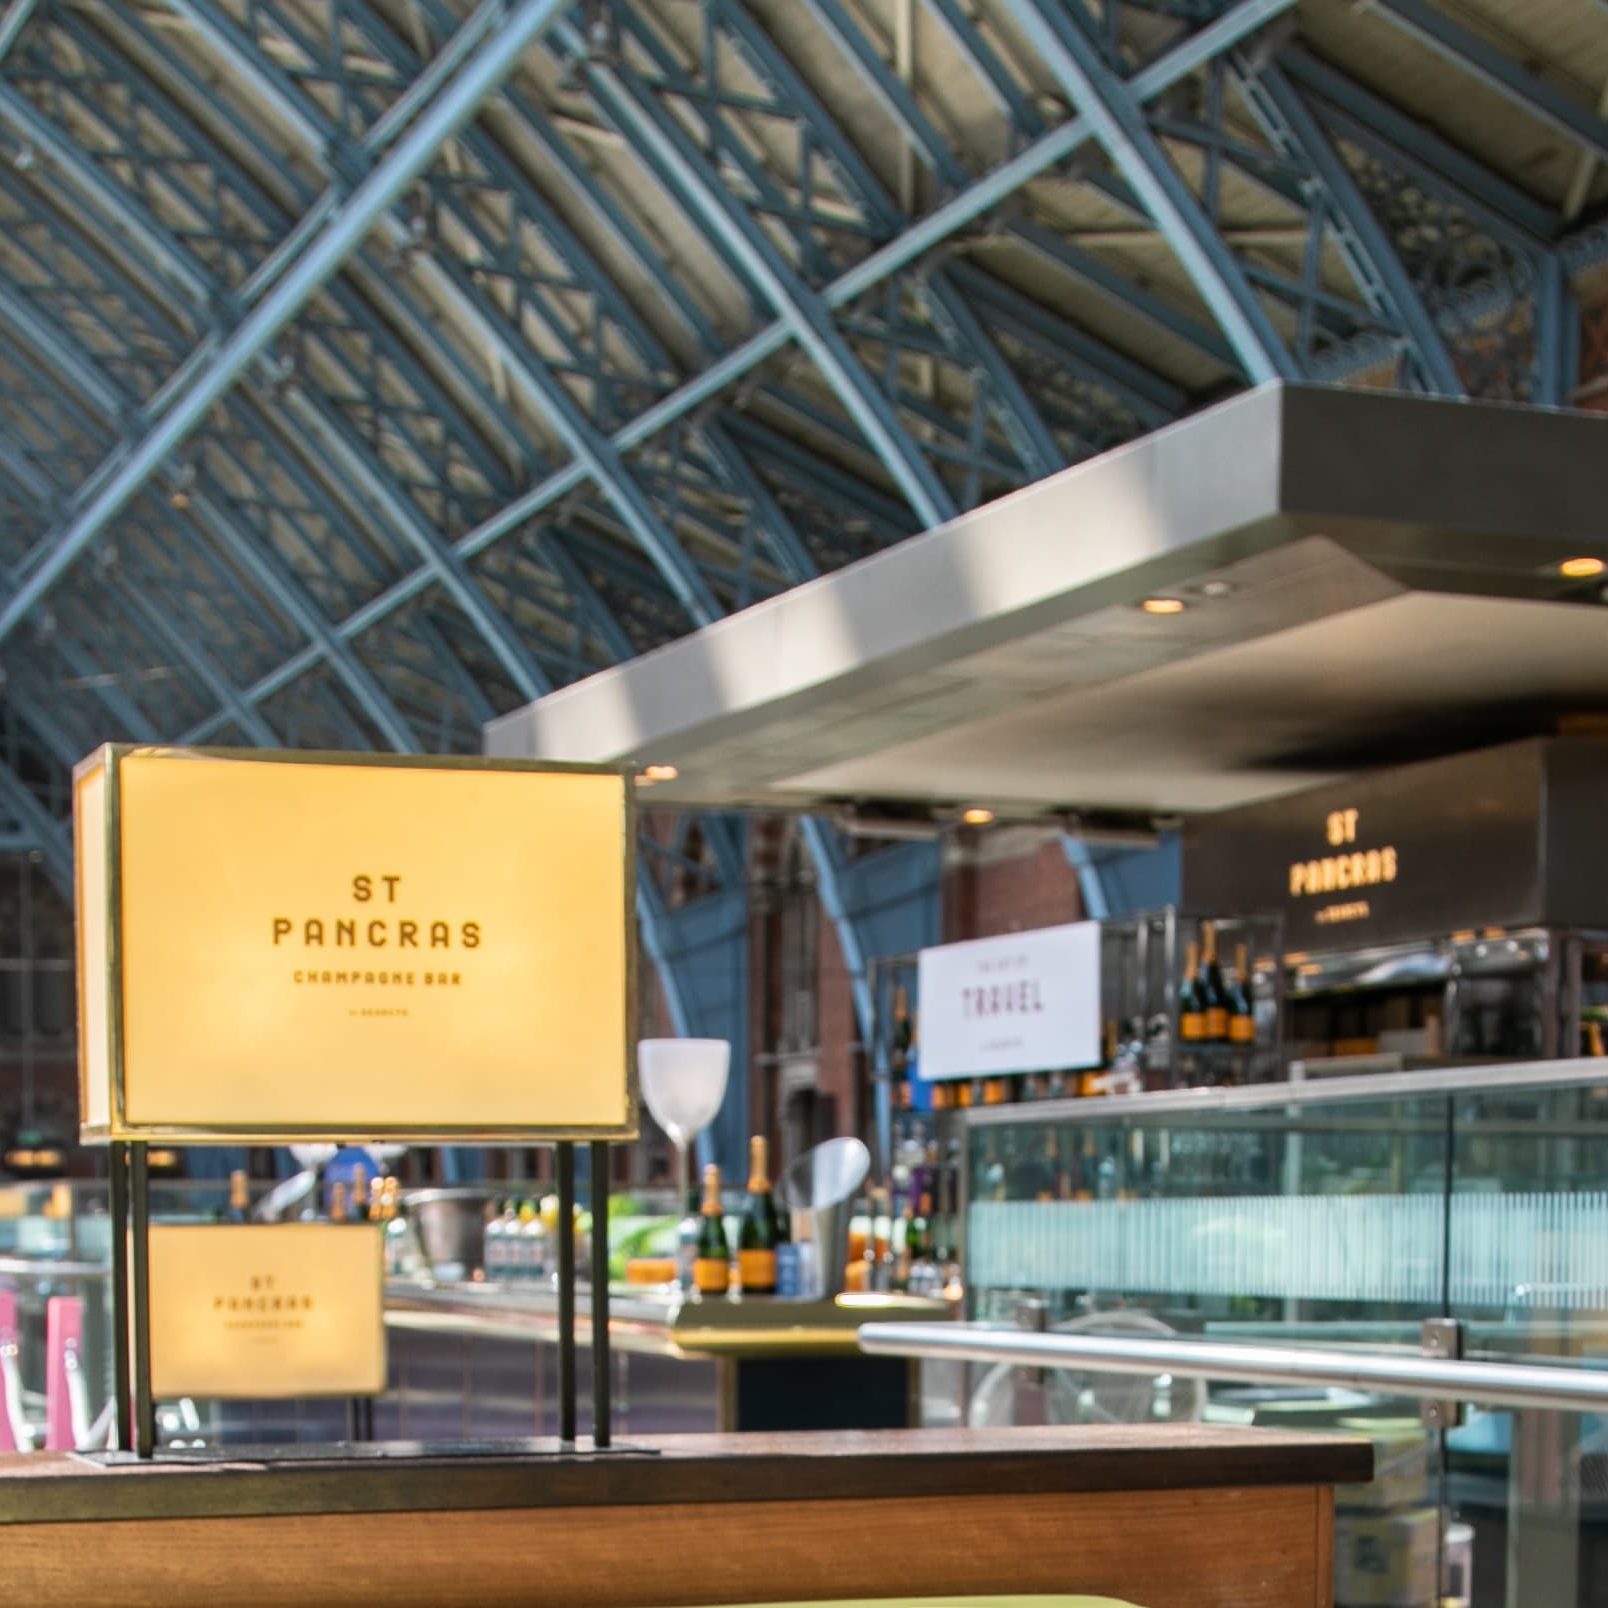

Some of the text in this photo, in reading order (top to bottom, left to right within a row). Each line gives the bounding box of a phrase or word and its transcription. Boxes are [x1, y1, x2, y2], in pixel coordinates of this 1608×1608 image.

[1326, 807, 1359, 846] ST
[1289, 845, 1398, 897] PANCRAS
[352, 874, 401, 903] ST
[272, 917, 482, 949] PANCRAS
[293, 970, 462, 987] CHAMPAGNE BAR
